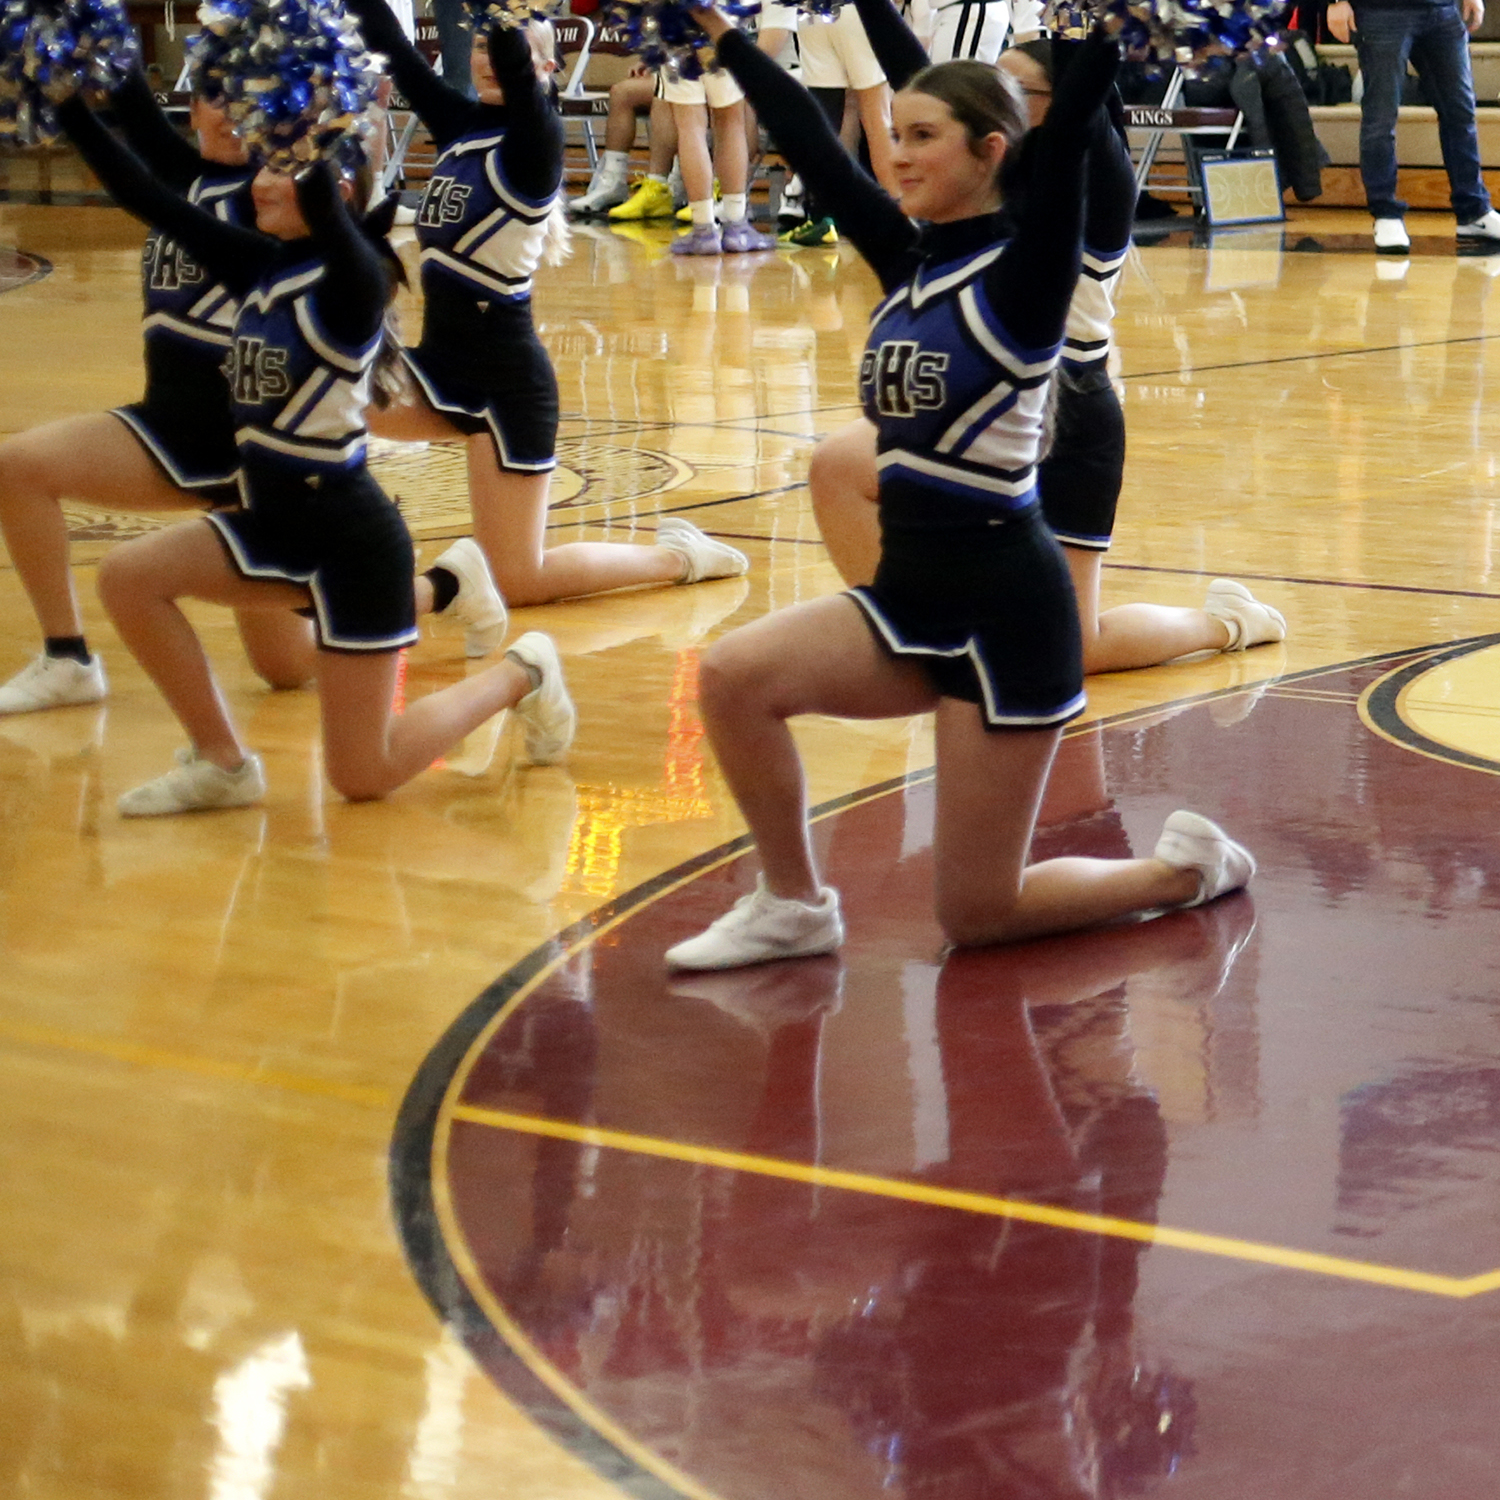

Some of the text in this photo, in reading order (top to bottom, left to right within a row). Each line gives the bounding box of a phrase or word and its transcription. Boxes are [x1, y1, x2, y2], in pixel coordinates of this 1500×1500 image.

[556, 26, 579, 43] YHI
[1131, 110, 1173, 125] KINGS
[417, 176, 472, 228] HS
